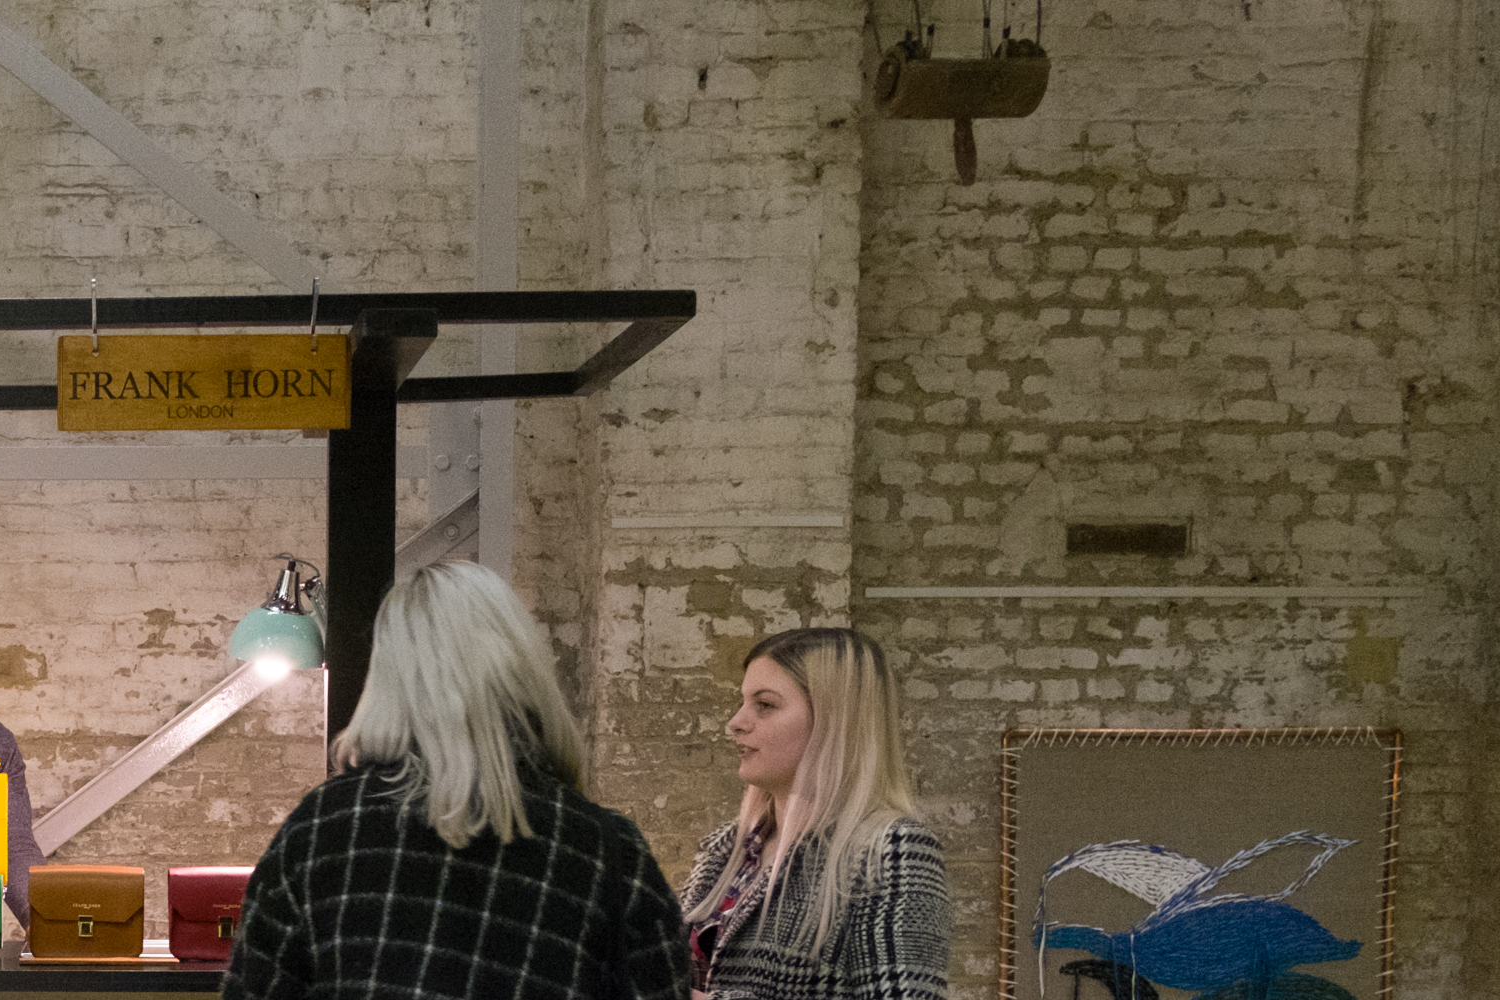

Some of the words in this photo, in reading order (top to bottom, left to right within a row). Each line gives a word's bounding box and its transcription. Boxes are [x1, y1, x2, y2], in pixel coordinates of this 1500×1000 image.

[68, 370, 200, 400] FRANK
[223, 368, 336, 399] HORN
[167, 404, 234, 419] LONDON
